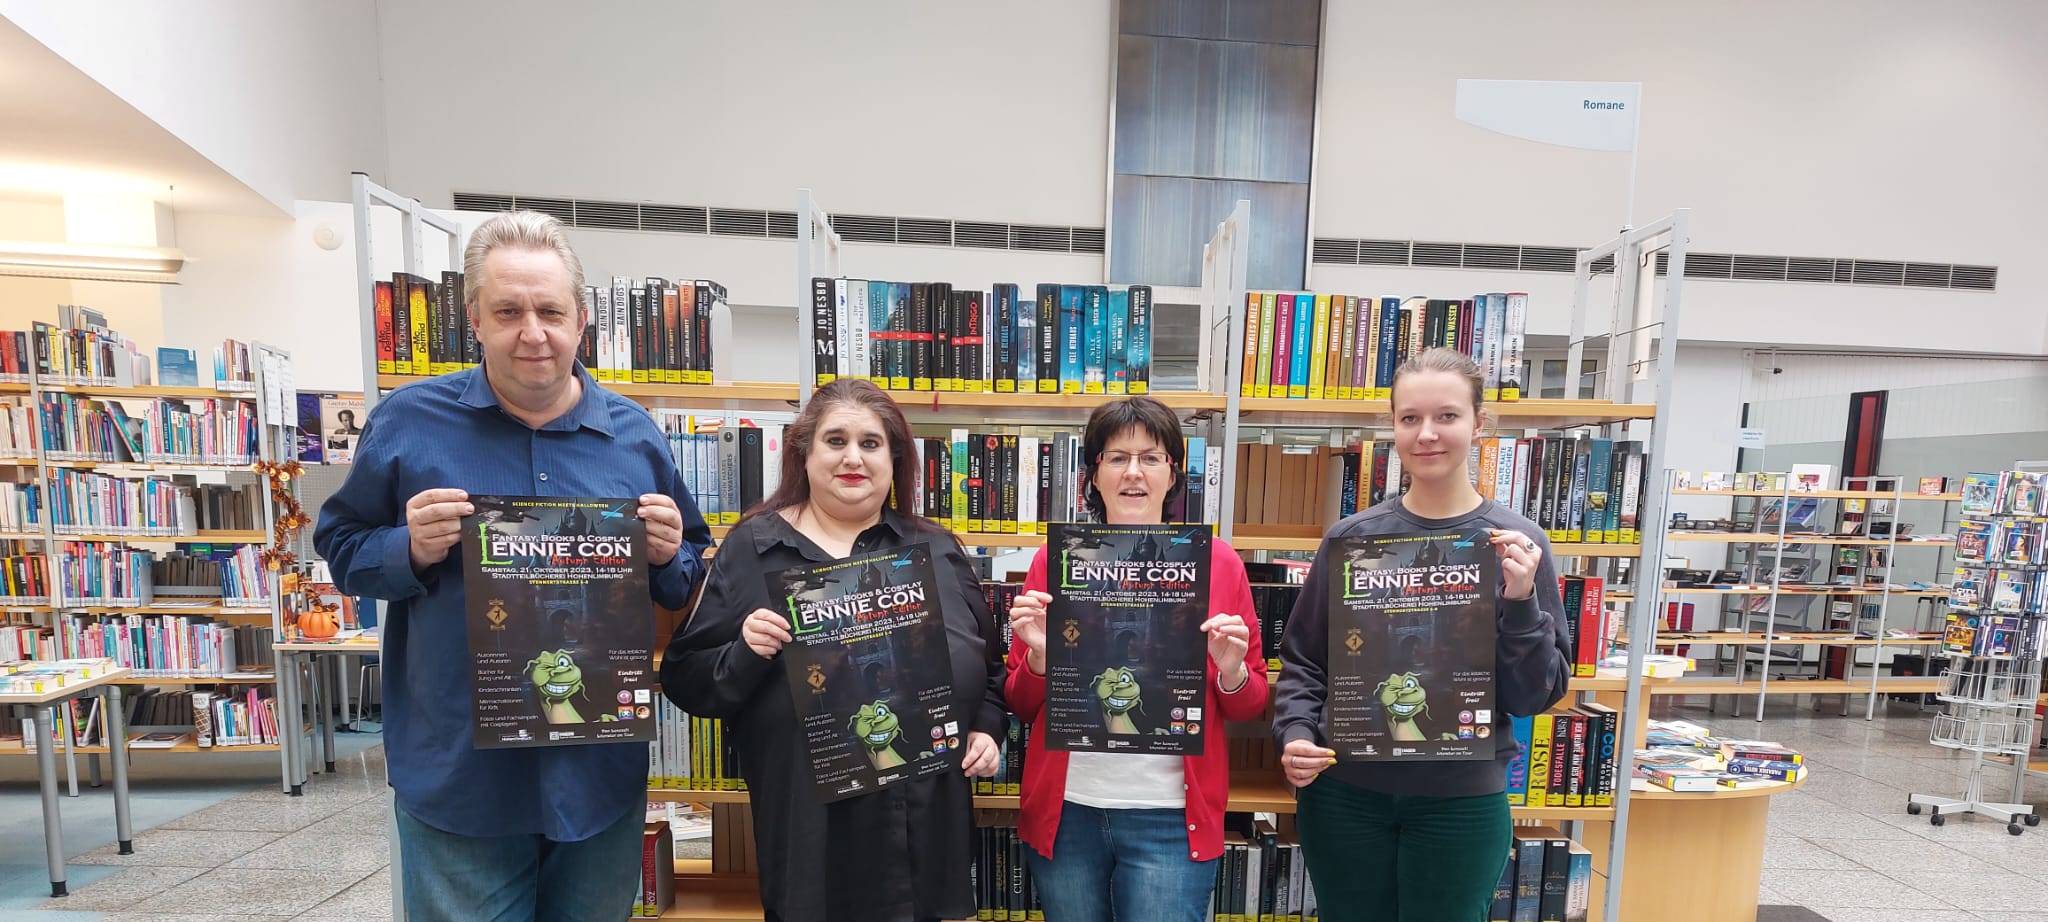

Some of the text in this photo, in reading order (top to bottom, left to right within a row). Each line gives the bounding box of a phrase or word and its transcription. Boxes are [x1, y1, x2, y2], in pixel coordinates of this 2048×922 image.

[1583, 100, 1625, 110] Romane
[447, 289, 456, 315] perfekte
[599, 296, 607, 331] RAIN DOGS
[616, 287, 625, 325] RAIN DOGS
[816, 281, 827, 330] JO NESBØ
[969, 302, 978, 335] INTRIGO
[1447, 304, 1458, 331] WASSER
[384, 322, 392, 353] Dermid
[419, 323, 427, 353] Dermid
[1000, 325, 1008, 362] NELE NEUHAUS
[1044, 326, 1052, 349] NEUHAUS
[1069, 326, 1077, 363] NELE NEUHAUS
[1509, 338, 1517, 363] RANKIN
[726, 454, 734, 493] WATCHERS
[1488, 446, 1497, 485] KNOCHEN
[1505, 446, 1513, 485] KNOCHEN
[1545, 499, 1553, 522] rendell
[1560, 499, 1568, 523] rendell
[492, 534, 632, 543] FANTASY, BOOKS & COSPLAY
[578, 542, 632, 557] CON
[593, 554, 626, 566] Edition
[1072, 559, 1112, 568] FANTASY,
[1114, 559, 1145, 567] BOOKS
[1155, 560, 1196, 568] COSPLAY
[1354, 568, 1396, 577] FANTASY,
[1397, 566, 1428, 574] BOOKS
[1438, 563, 1481, 572] COSPLAY
[1146, 568, 1196, 581] CON
[1160, 580, 1191, 590] Edition
[1429, 570, 1481, 587] CON
[800, 580, 923, 612] FANTASY, BOOKS & COSPLAY
[877, 587, 926, 609] CON
[1443, 582, 1474, 593] Edition
[842, 622, 874, 634] OKTOBER
[1273, 619, 1283, 650] ROBB
[1573, 722, 1582, 732] DER
[1530, 738, 1550, 790] ROSE
[1552, 743, 1565, 787] TODESFALLE
[1571, 766, 1580, 776] DES
[1572, 753, 1580, 766] ARM
[1013, 865, 1022, 894] CULT
